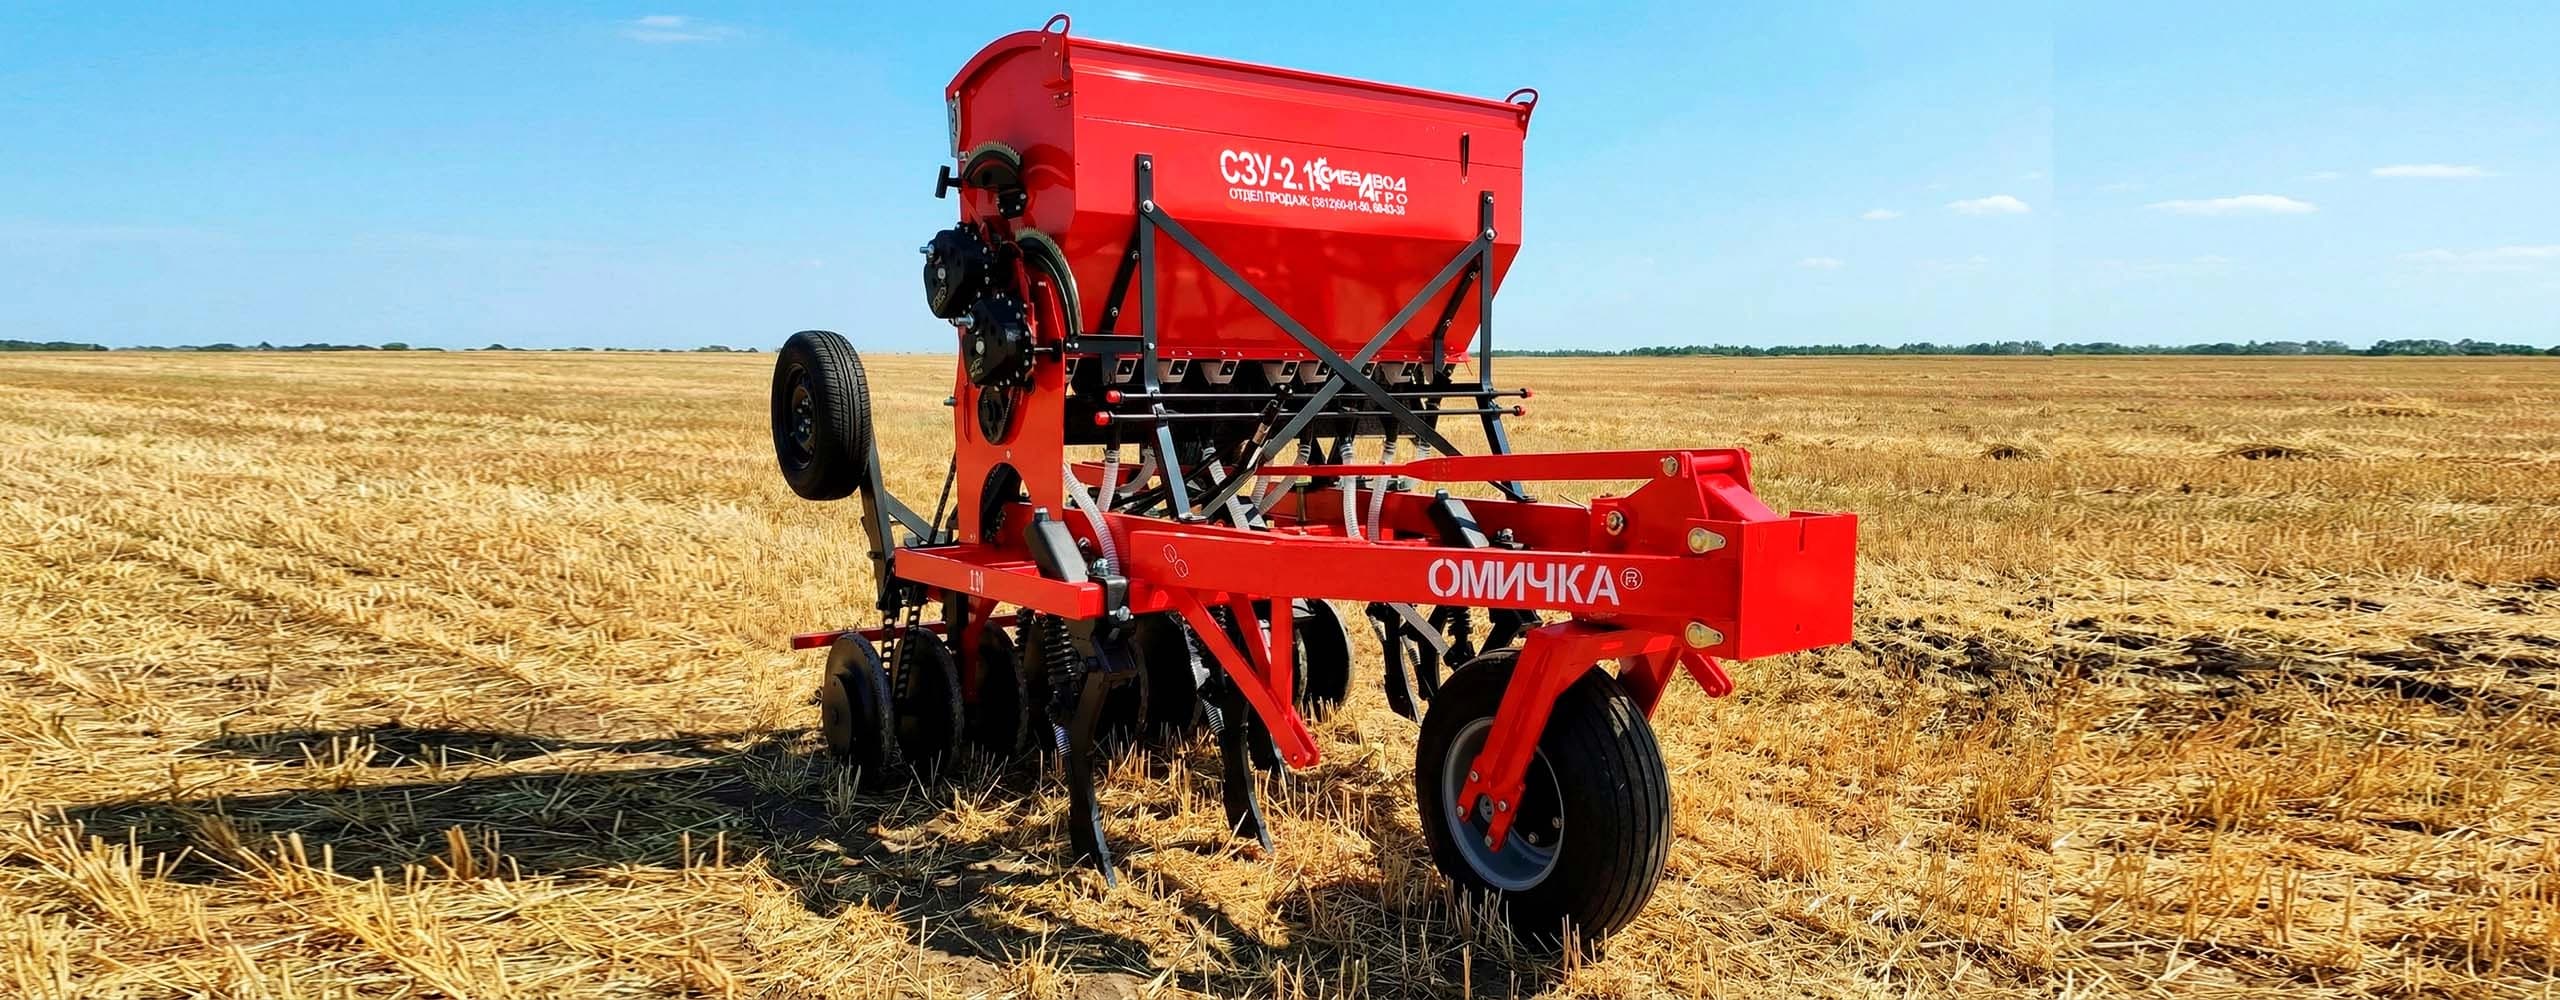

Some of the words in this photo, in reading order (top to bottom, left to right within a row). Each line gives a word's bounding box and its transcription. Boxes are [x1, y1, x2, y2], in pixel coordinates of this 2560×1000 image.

[1220, 149, 1314, 192] СЗУ-2.1
[1229, 187, 1264, 203] ОТДЕЛ
[1267, 191, 1310, 207] ПРОДАЖ:
[1428, 557, 1620, 606] ОМИЧКА
